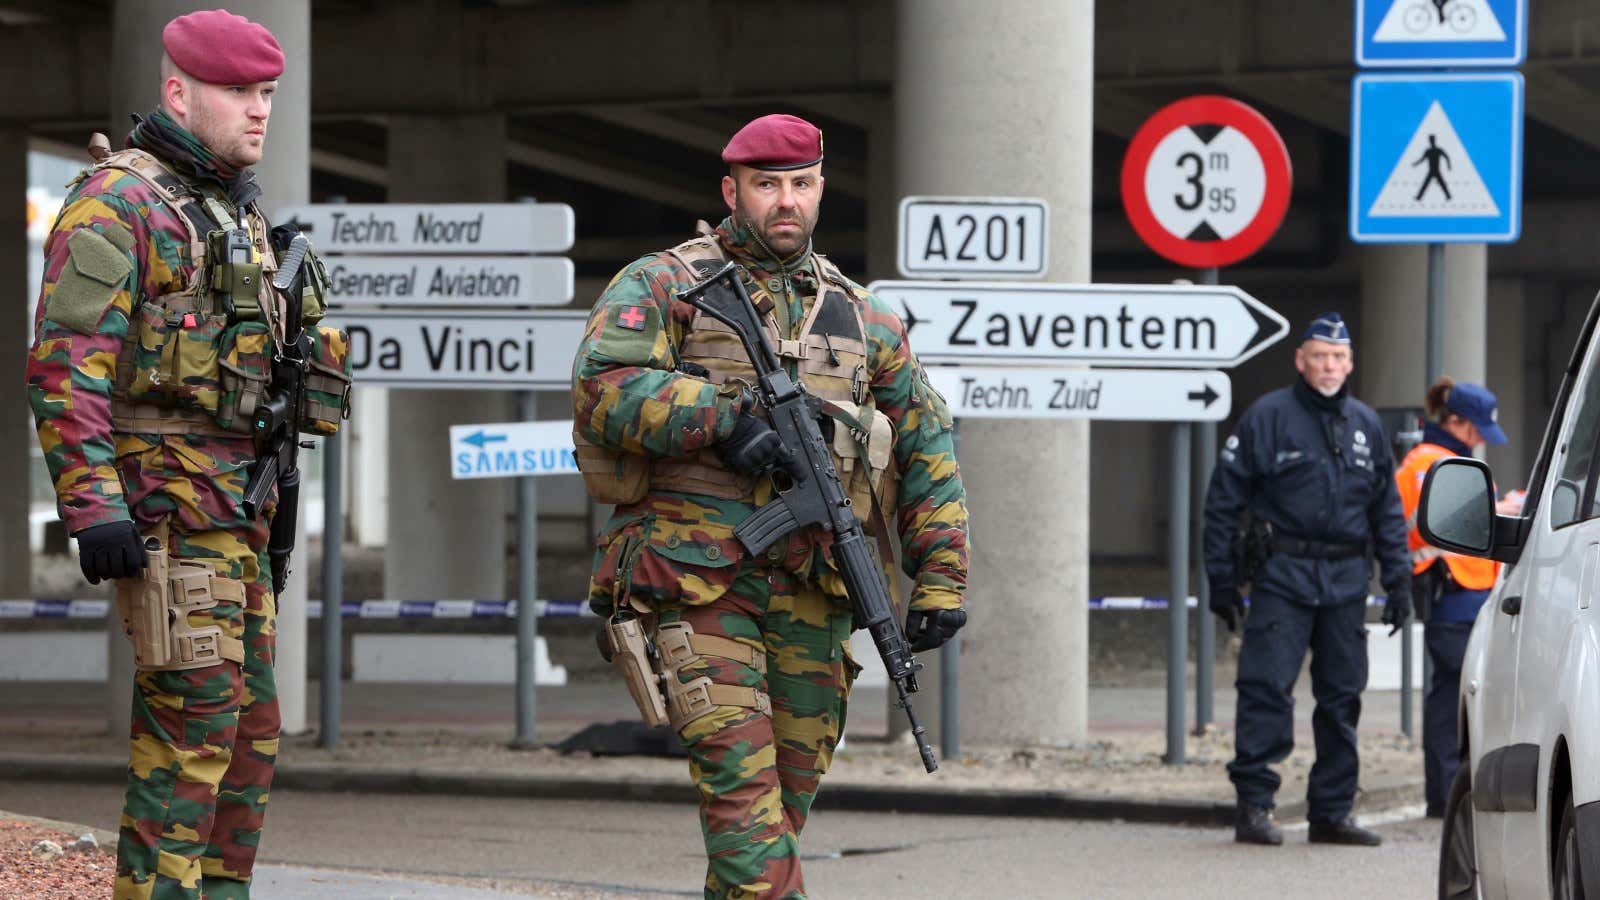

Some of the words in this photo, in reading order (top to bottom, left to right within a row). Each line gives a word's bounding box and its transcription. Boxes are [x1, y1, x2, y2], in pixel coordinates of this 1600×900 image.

[1208, 151, 1230, 172] m
[1174, 152, 1205, 212] 3
[1208, 187, 1237, 213] 95
[331, 212, 398, 243] Techn.
[413, 212, 484, 243] Noord
[923, 214, 1027, 262] A201
[330, 265, 417, 297] General
[428, 265, 520, 297] Aviation
[947, 300, 1218, 351] Zaventem
[346, 326, 402, 371] Da
[420, 326, 534, 373] Vinci
[960, 377, 1033, 409] Techn.
[1047, 378, 1104, 410] Zuid
[457, 448, 577, 473] SAMSUN
